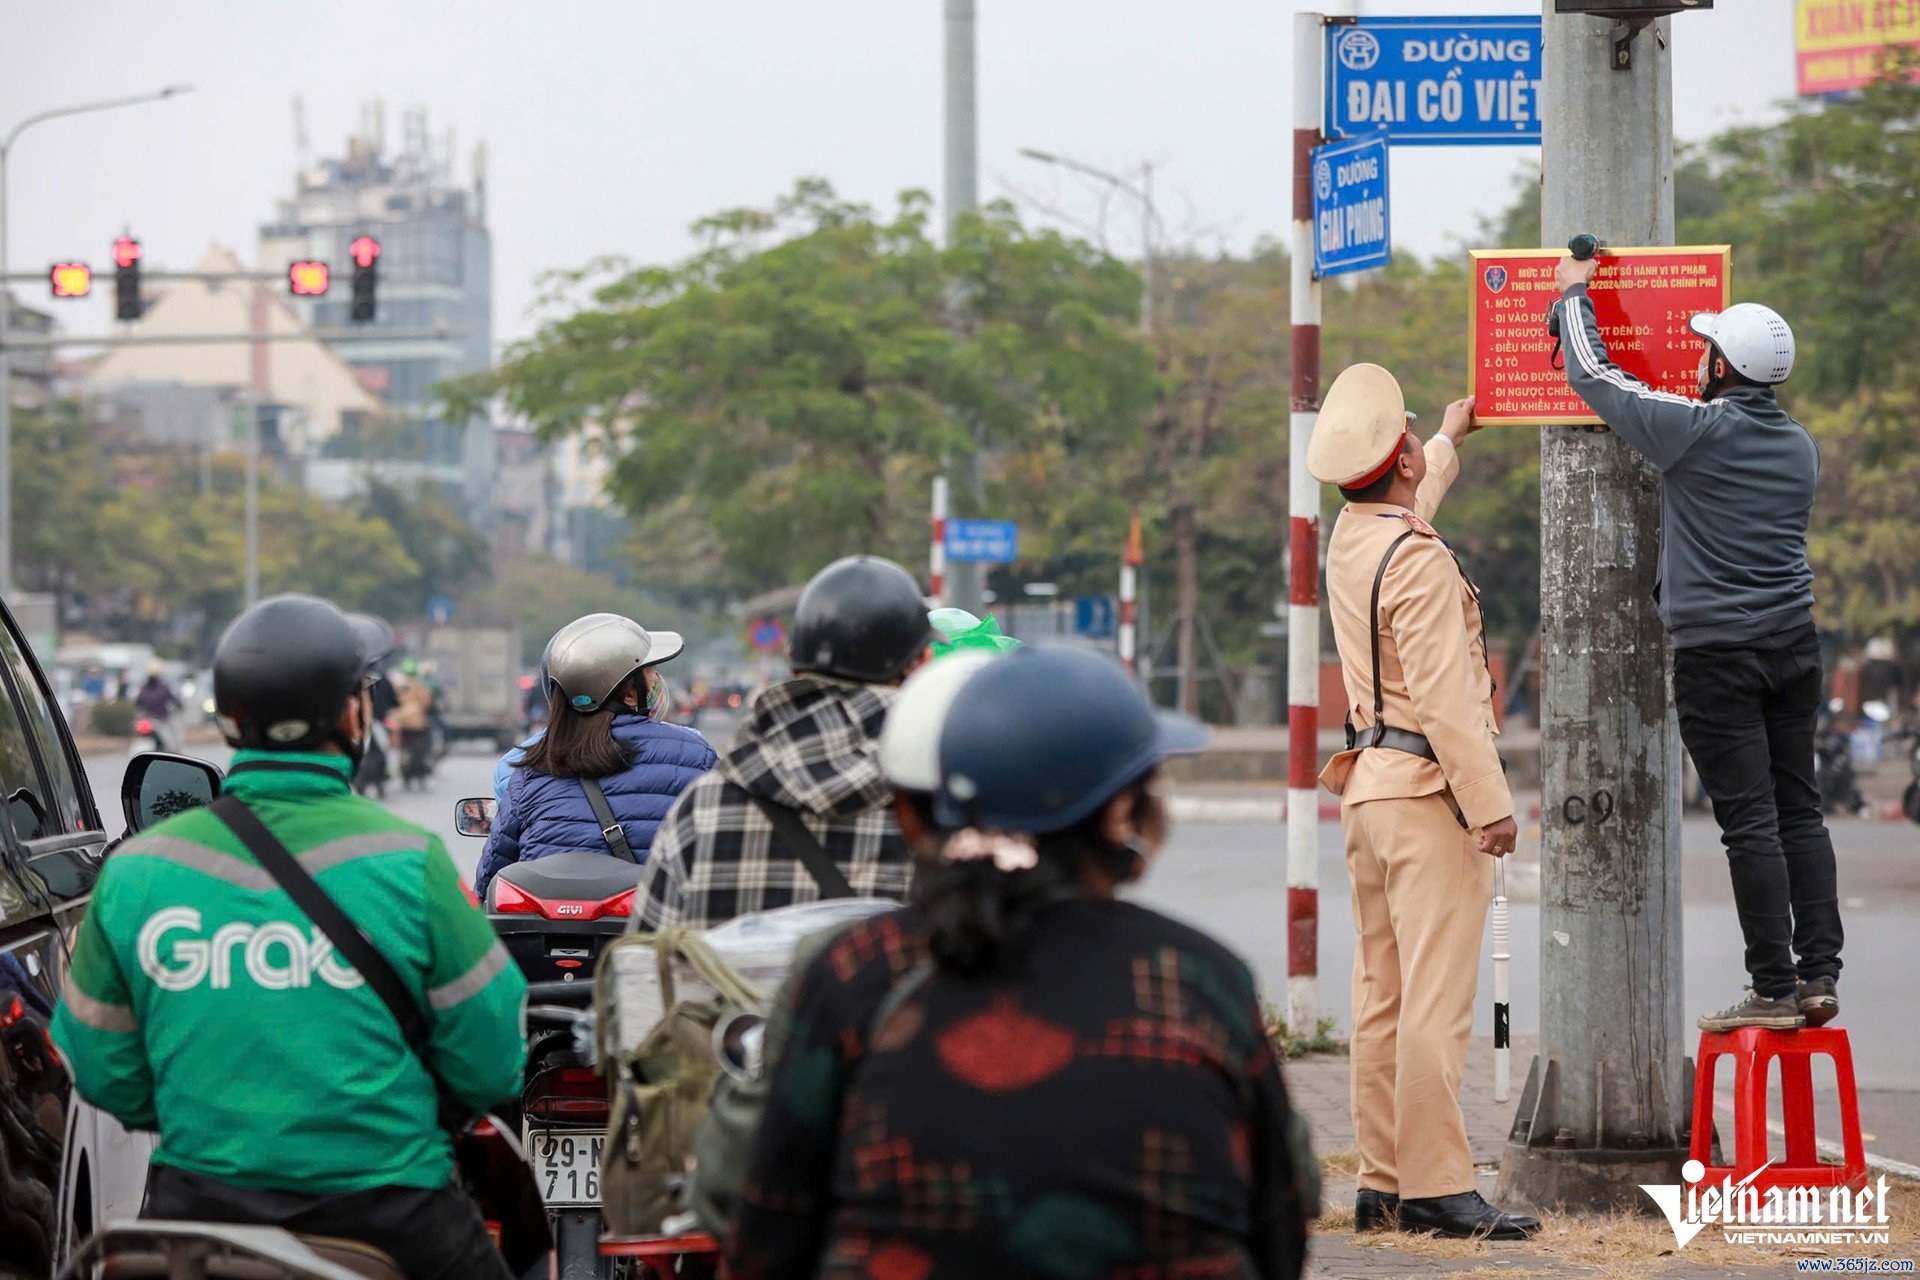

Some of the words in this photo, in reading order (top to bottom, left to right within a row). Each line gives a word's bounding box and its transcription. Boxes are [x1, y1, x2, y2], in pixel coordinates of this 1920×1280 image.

[1402, 33, 1531, 62] ĐƯỜNG
[1347, 80, 1407, 130] ĐẠI
[1474, 70, 1542, 130] VIỆT
[1336, 153, 1379, 188] ĐƯỜNG
[1599, 265, 1618, 279] MỘT
[1620, 263, 1632, 276] SỐ
[1634, 264, 1657, 276] HÀNH
[1660, 265, 1669, 275] VI
[1670, 265, 1679, 275] VI
[1681, 264, 1707, 277] PHẠM
[1510, 282, 1532, 291] THEO
[1650, 277, 1669, 288] CỦA
[1670, 276, 1697, 288] CHÍNH
[1495, 297, 1511, 308] MÔ
[1513, 297, 1526, 308] TÔ
[1495, 314, 1505, 323] ĐI
[1508, 313, 1528, 322] VÀO
[1666, 310, 1673, 320] 2
[1680, 310, 1686, 320] 3
[1495, 329, 1505, 338] ĐI
[1507, 328, 1545, 339] NGƯỢC
[1666, 326, 1672, 335] 4
[1680, 326, 1686, 335] 6
[1666, 341, 1673, 350] 4
[1680, 341, 1687, 350] 6
[1484, 359, 1493, 368] 2.
[1495, 372, 1505, 382] ĐI
[1508, 372, 1528, 382] VÀO
[1661, 370, 1668, 380] 4
[1680, 370, 1687, 380] 6
[1495, 387, 1505, 397] ĐI
[1507, 387, 1545, 398] NGƯỢC
[1675, 385, 1686, 395] 20
[1553, 402, 1565, 411] XE
[1568, 402, 1578, 411] ĐI
